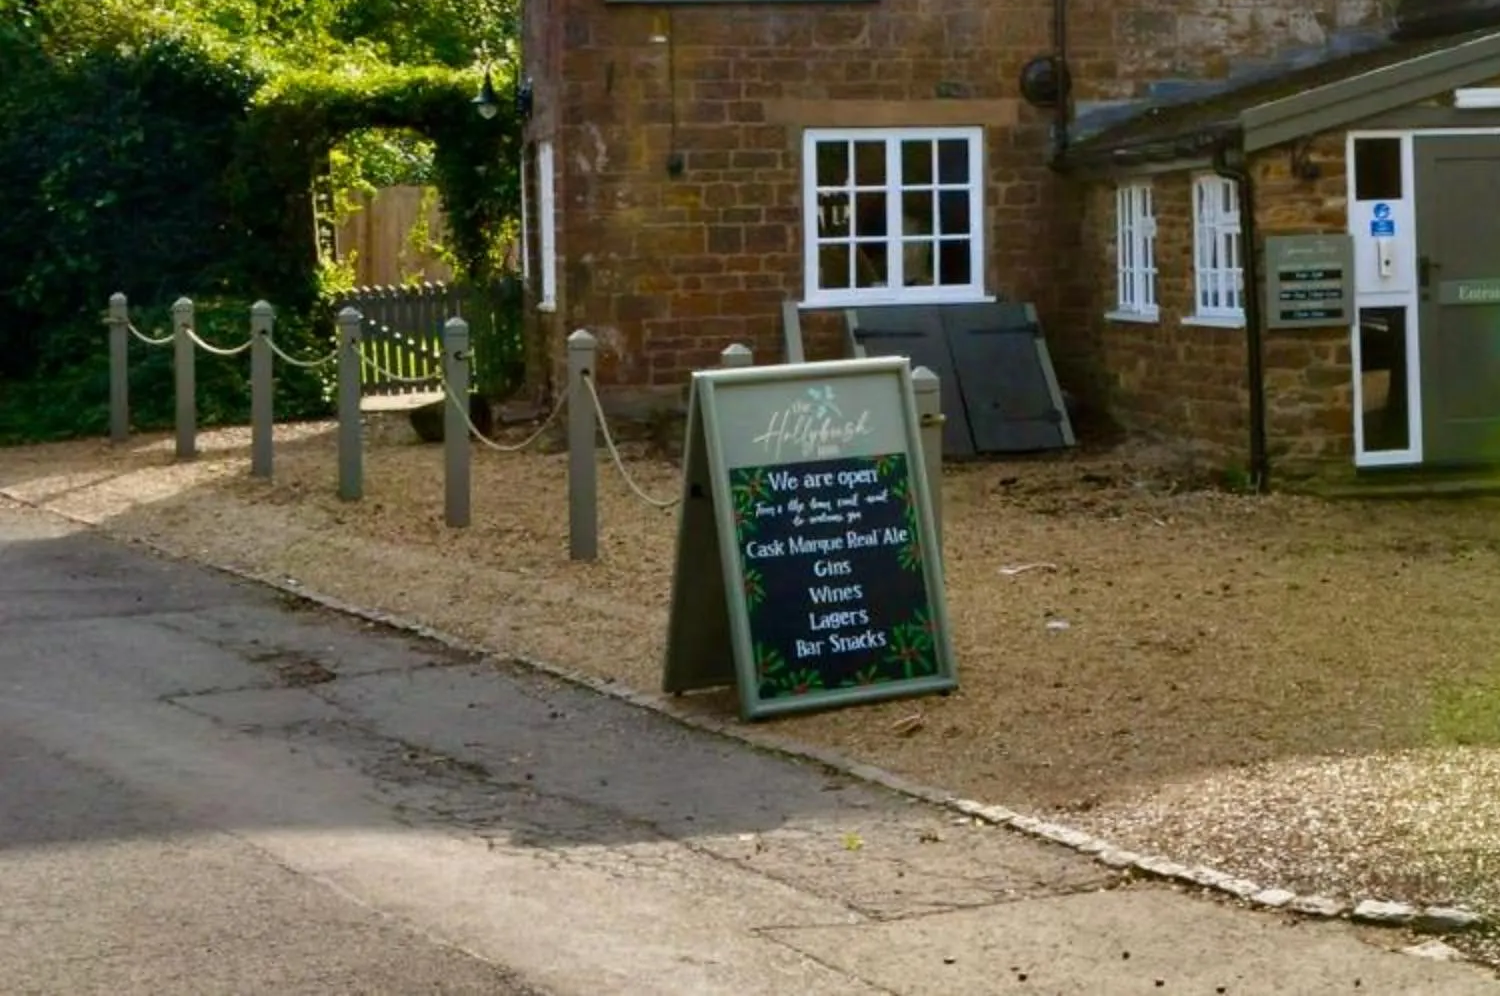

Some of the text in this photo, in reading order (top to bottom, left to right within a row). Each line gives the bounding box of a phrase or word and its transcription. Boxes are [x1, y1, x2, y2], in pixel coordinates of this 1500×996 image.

[752, 409, 873, 461] Hollybush
[767, 469, 878, 491] We are open
[745, 527, 908, 559] Cask Marque Real Ale
[813, 560, 852, 577] Gins
[808, 584, 863, 604] Wines
[808, 609, 870, 631] Lagers
[795, 630, 887, 658] Bar Snacks
